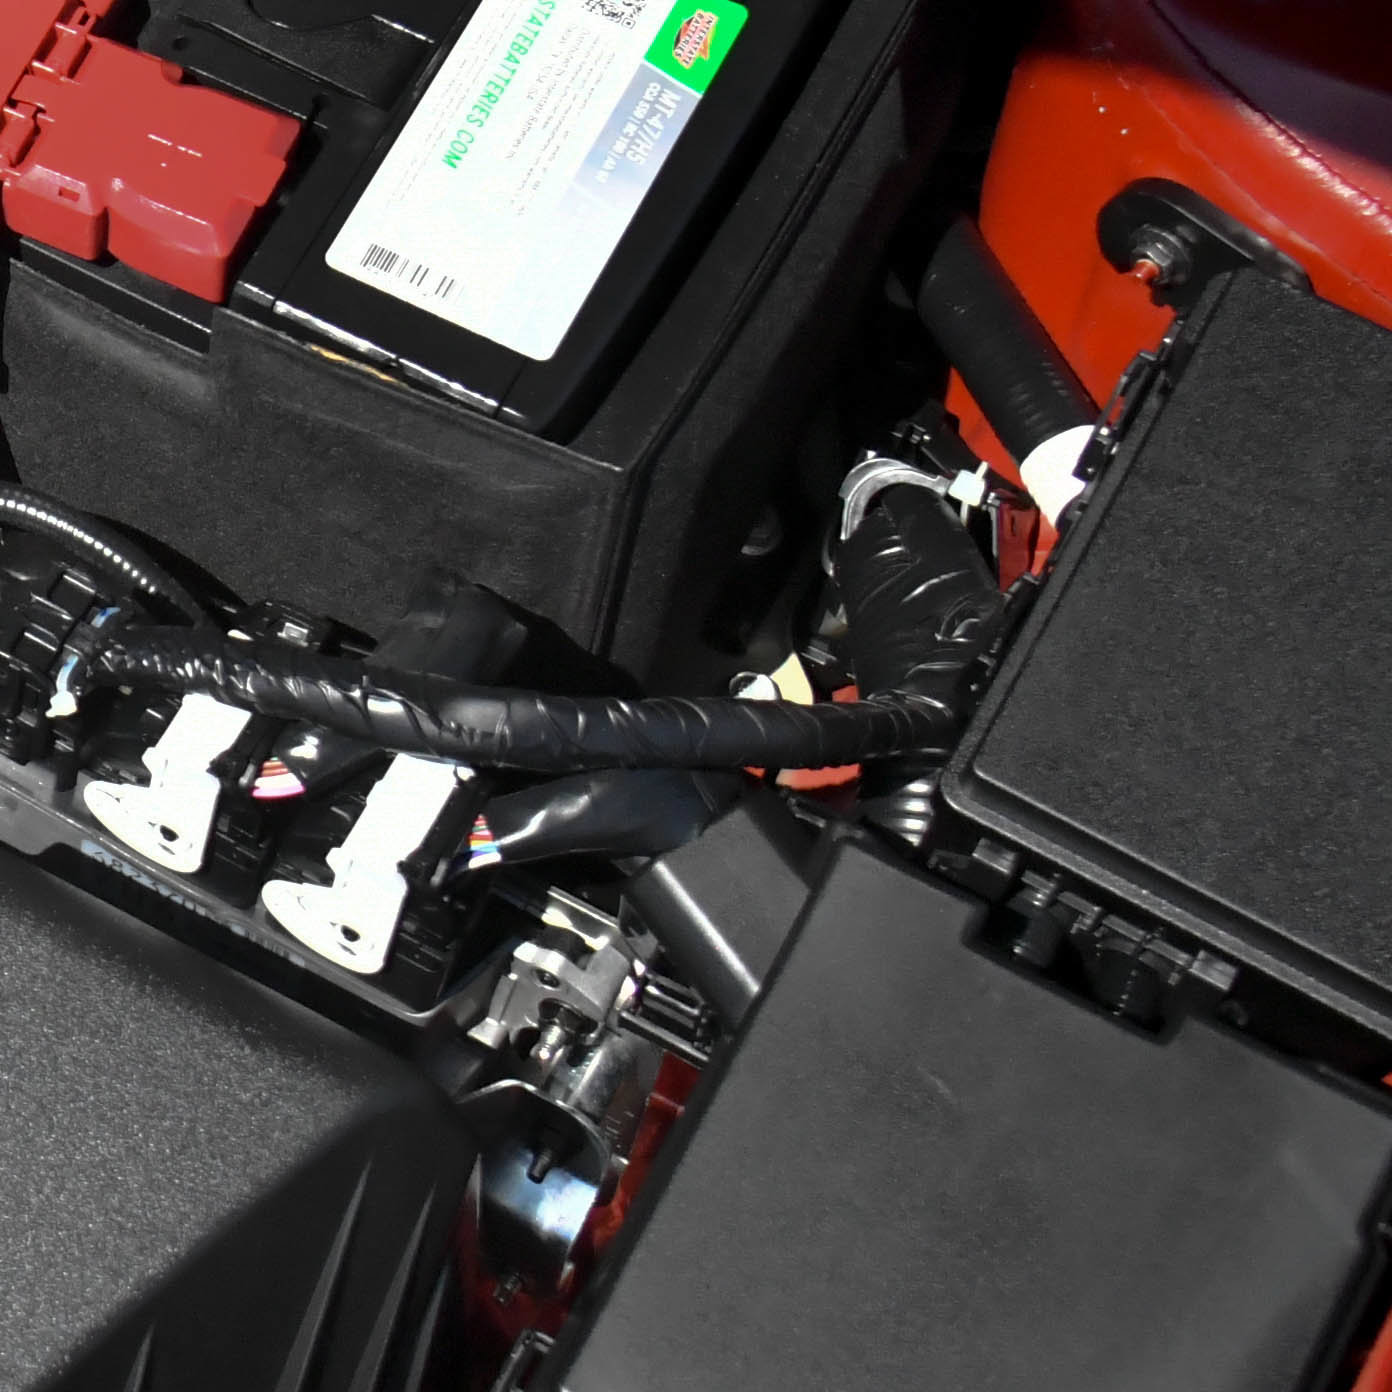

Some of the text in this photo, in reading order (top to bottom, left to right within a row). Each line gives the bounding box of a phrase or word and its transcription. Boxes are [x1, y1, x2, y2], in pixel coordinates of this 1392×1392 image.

[673, 12, 704, 58] BATTERIES
[681, 14, 714, 65] INTERSTATE
[626, 89, 681, 165] MT-47/H5
